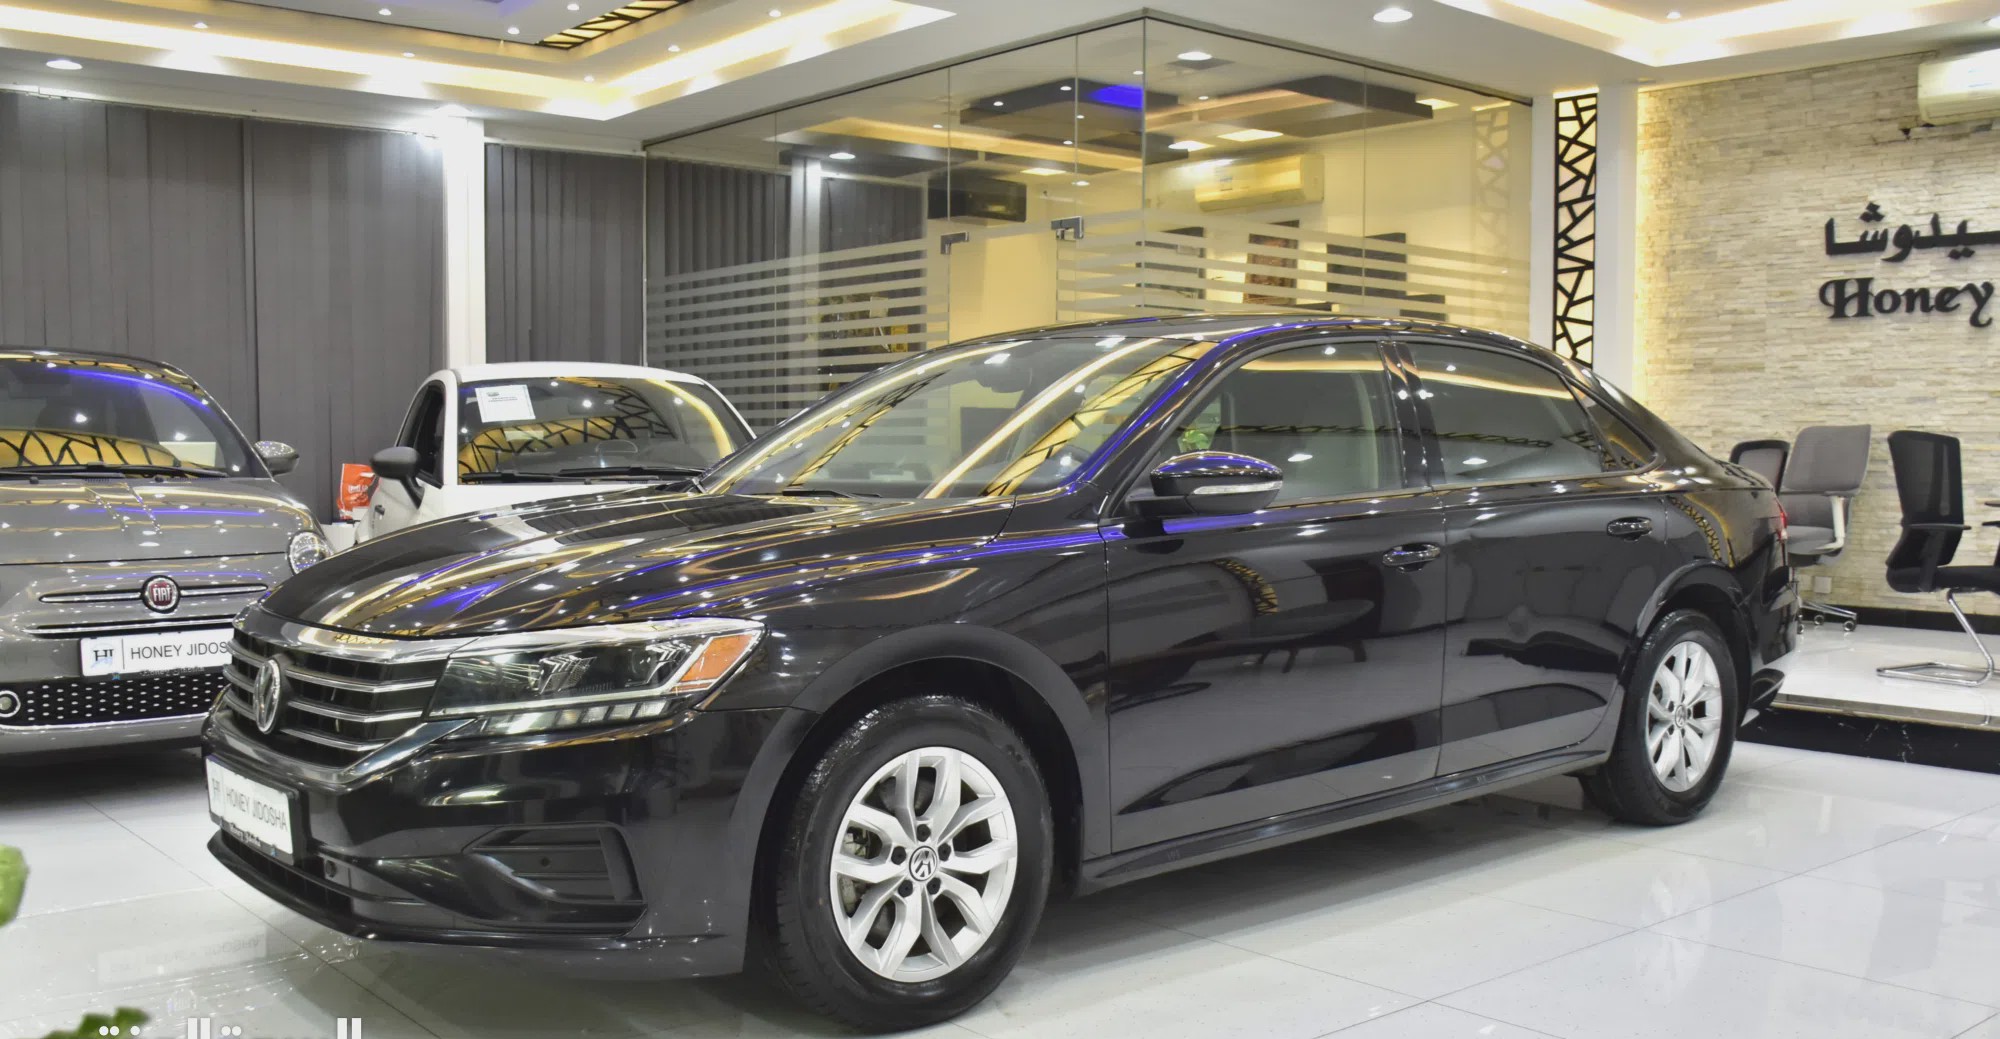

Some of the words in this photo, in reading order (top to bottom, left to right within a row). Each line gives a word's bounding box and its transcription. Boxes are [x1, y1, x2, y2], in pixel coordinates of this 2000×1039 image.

[1825, 202, 2000, 262] يدوشا
[1819, 277, 1994, 328] Honey
[152, 586, 171, 602] FIAT
[130, 644, 183, 660] HONEY
[186, 641, 228, 657] JIDOS
[225, 786, 250, 815] HONEY
[252, 799, 289, 832] JIDOSHA
